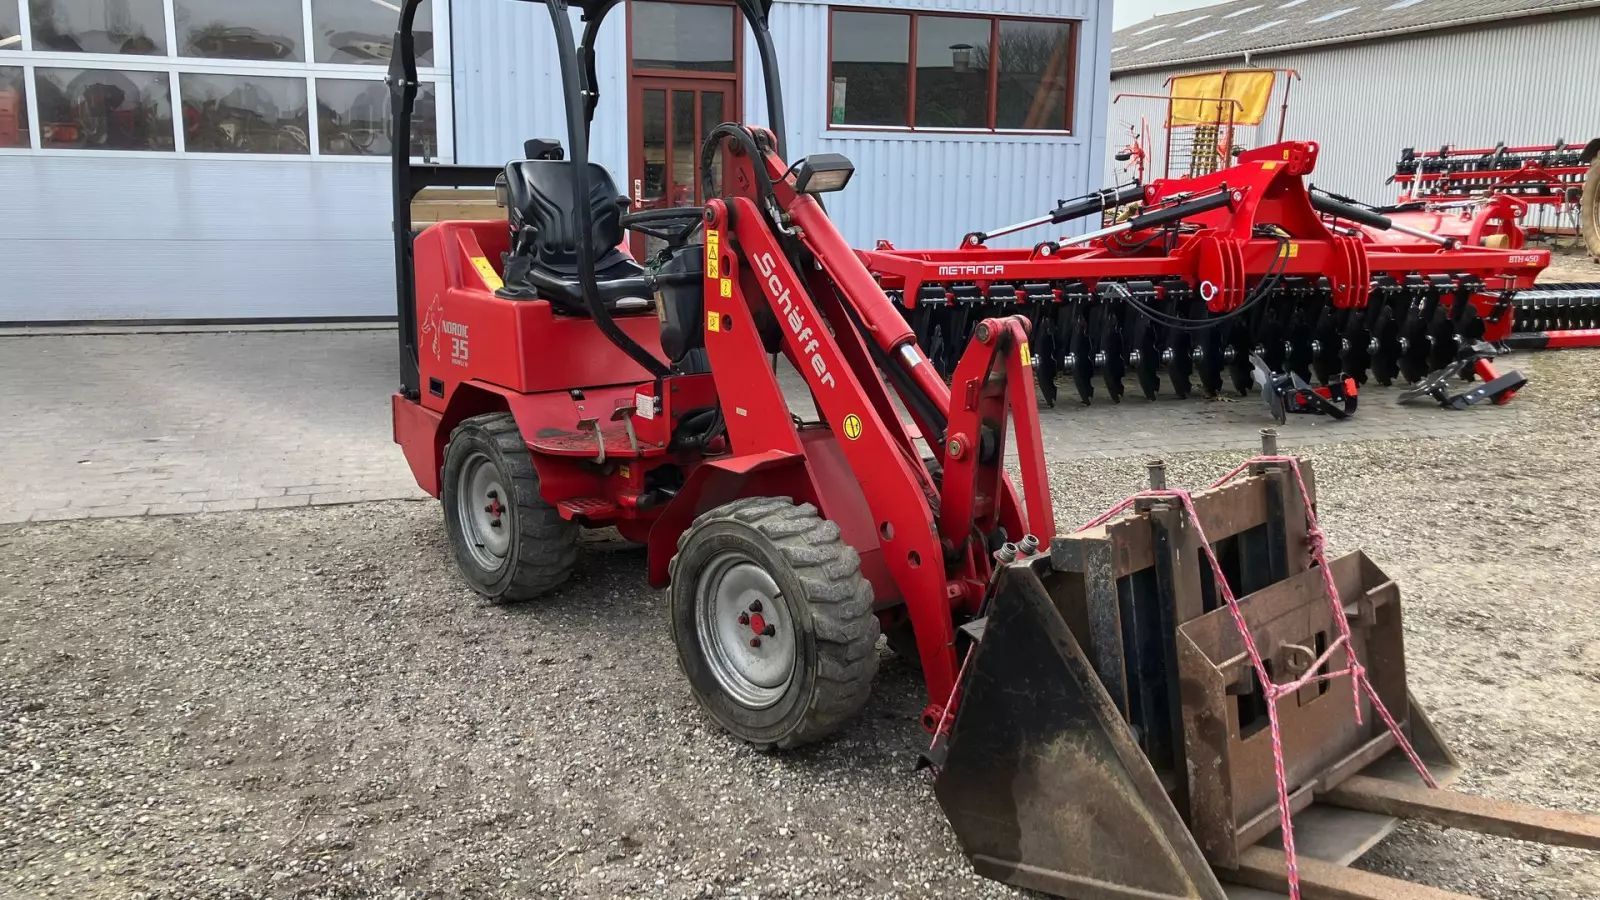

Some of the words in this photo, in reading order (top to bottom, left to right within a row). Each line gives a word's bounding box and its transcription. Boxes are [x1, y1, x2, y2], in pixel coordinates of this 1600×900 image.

[1525, 254, 1539, 262] 450
[938, 265, 1004, 276] METANGA
[442, 320, 469, 339] NORDIC
[752, 252, 836, 389] Schäffer
[451, 337, 469, 360] 35
